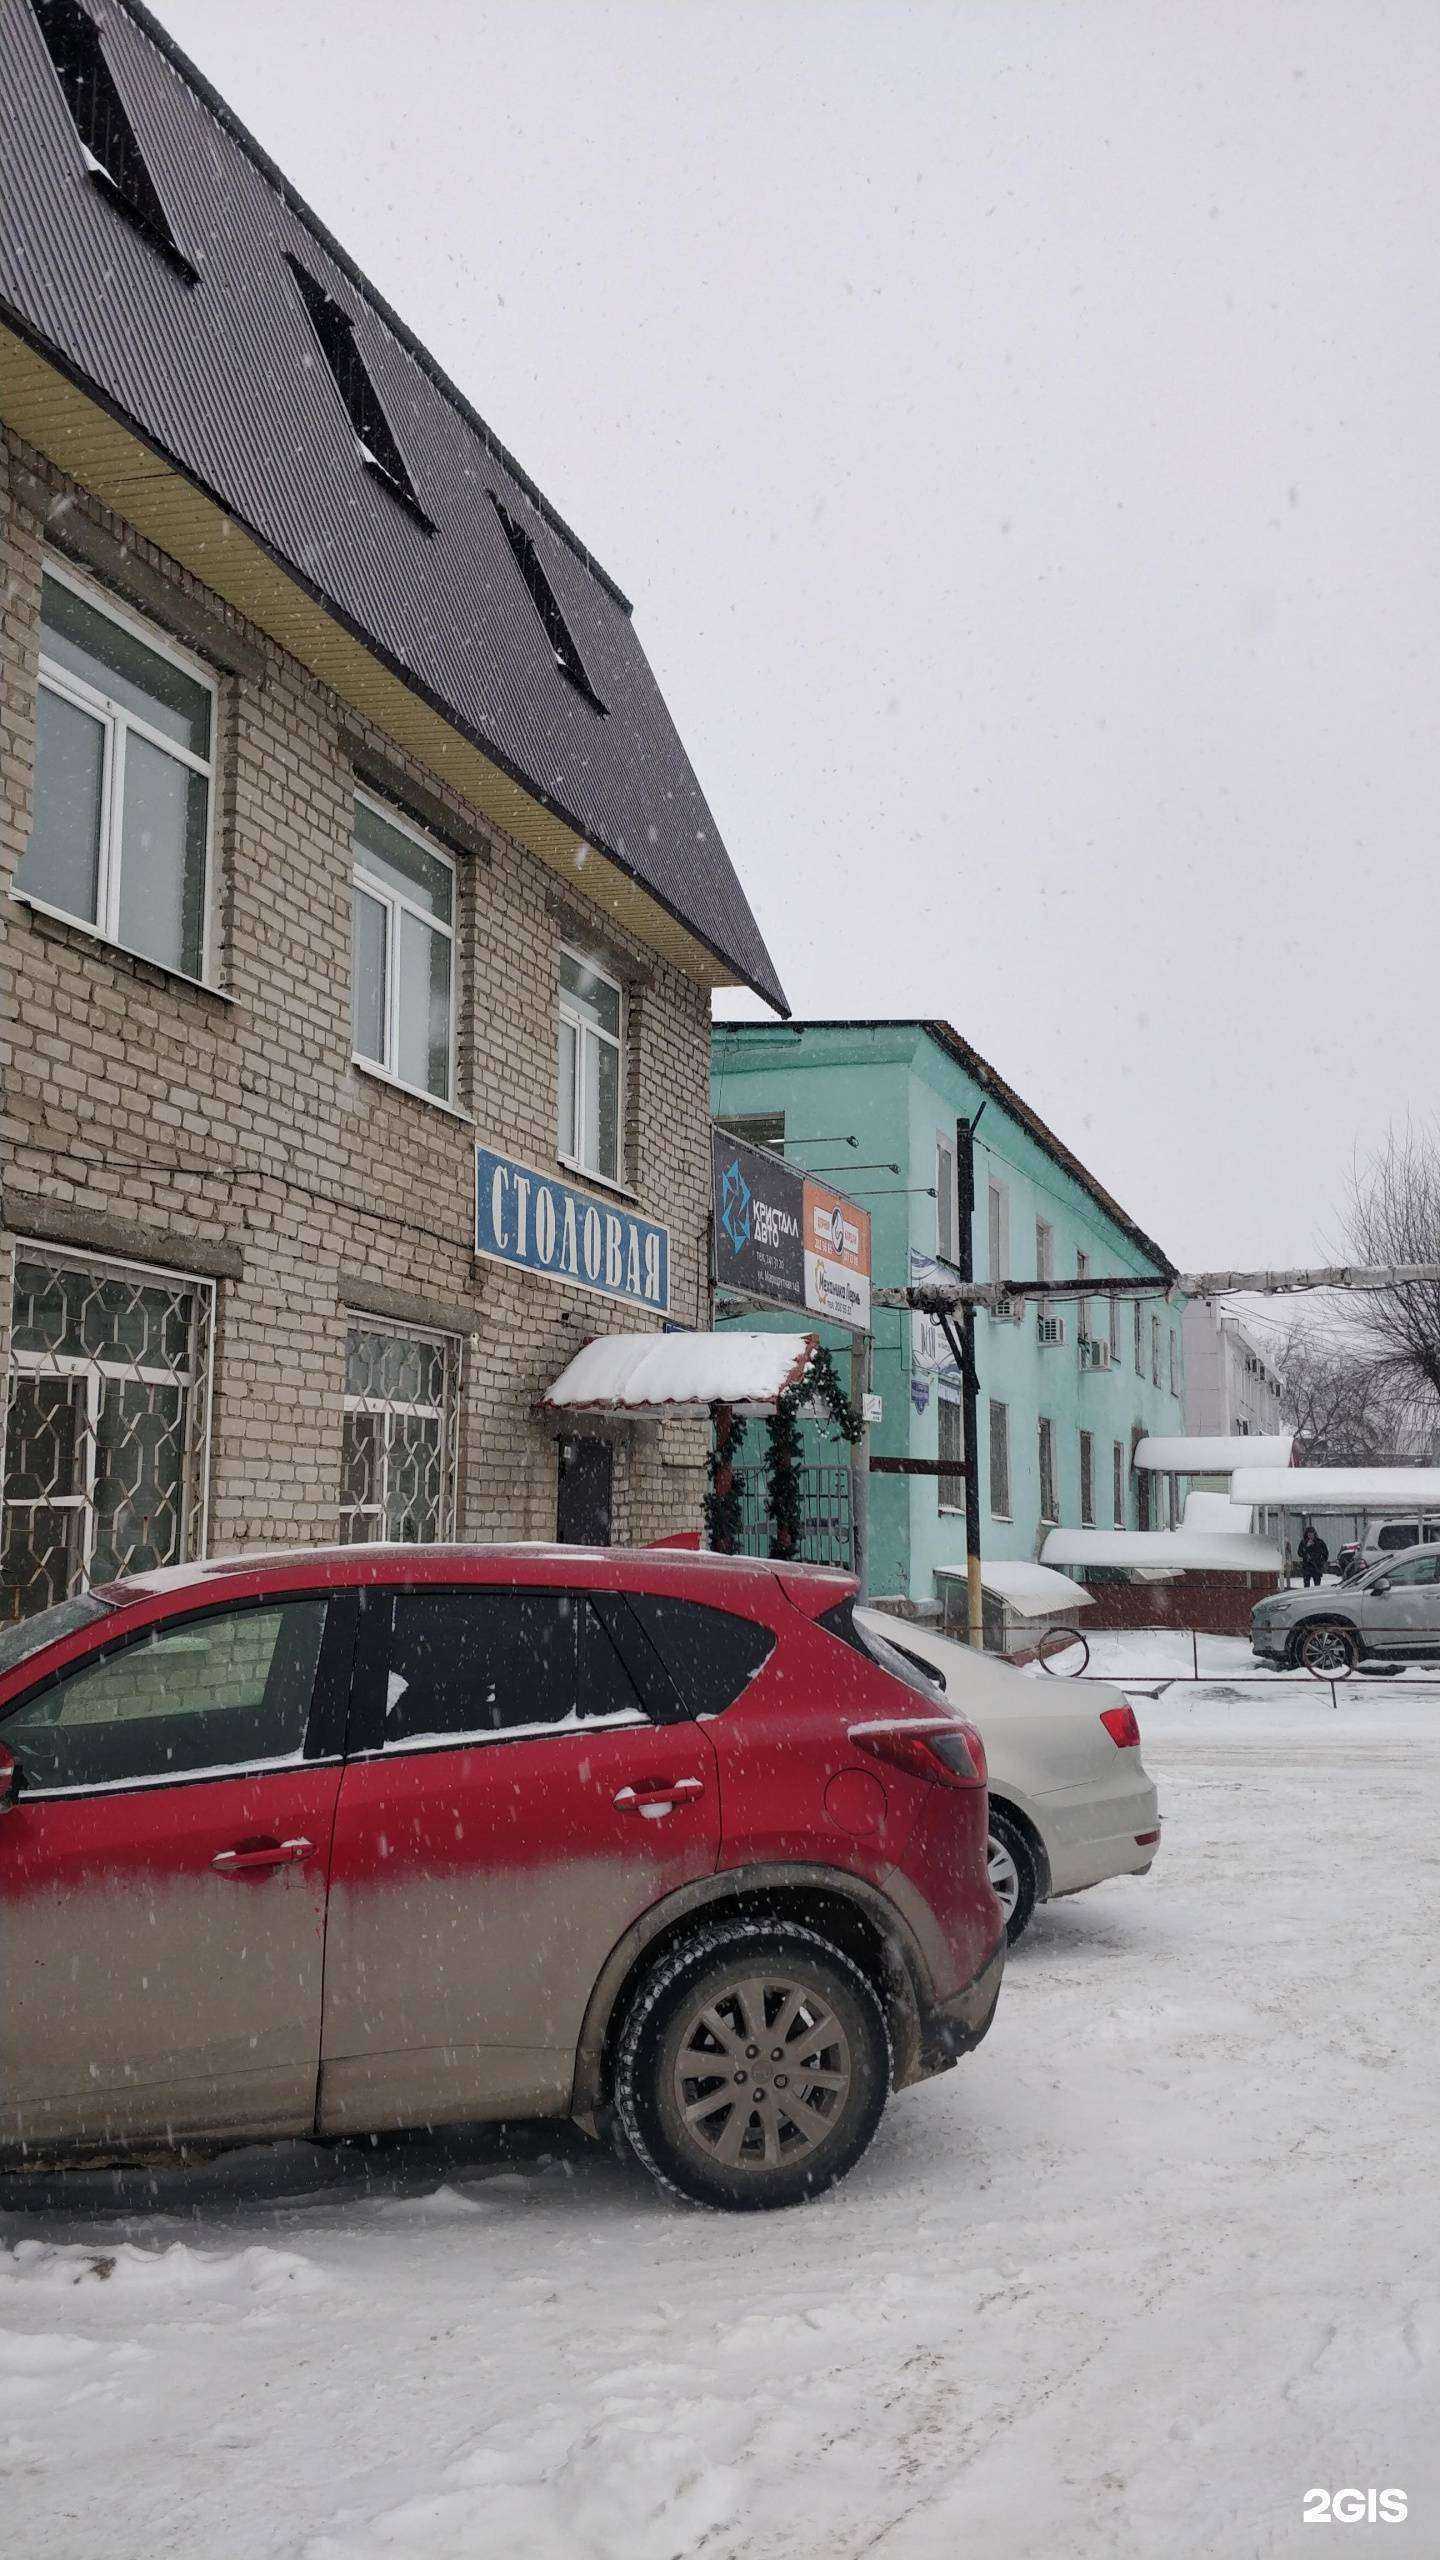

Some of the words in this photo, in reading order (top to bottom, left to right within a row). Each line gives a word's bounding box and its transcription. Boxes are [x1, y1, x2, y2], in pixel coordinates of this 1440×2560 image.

[491, 1164, 661, 1302] СТОЛОВАЯ
[752, 1199, 799, 1239] КРИСТАЛЛ
[753, 1219, 779, 1248] АВТО
